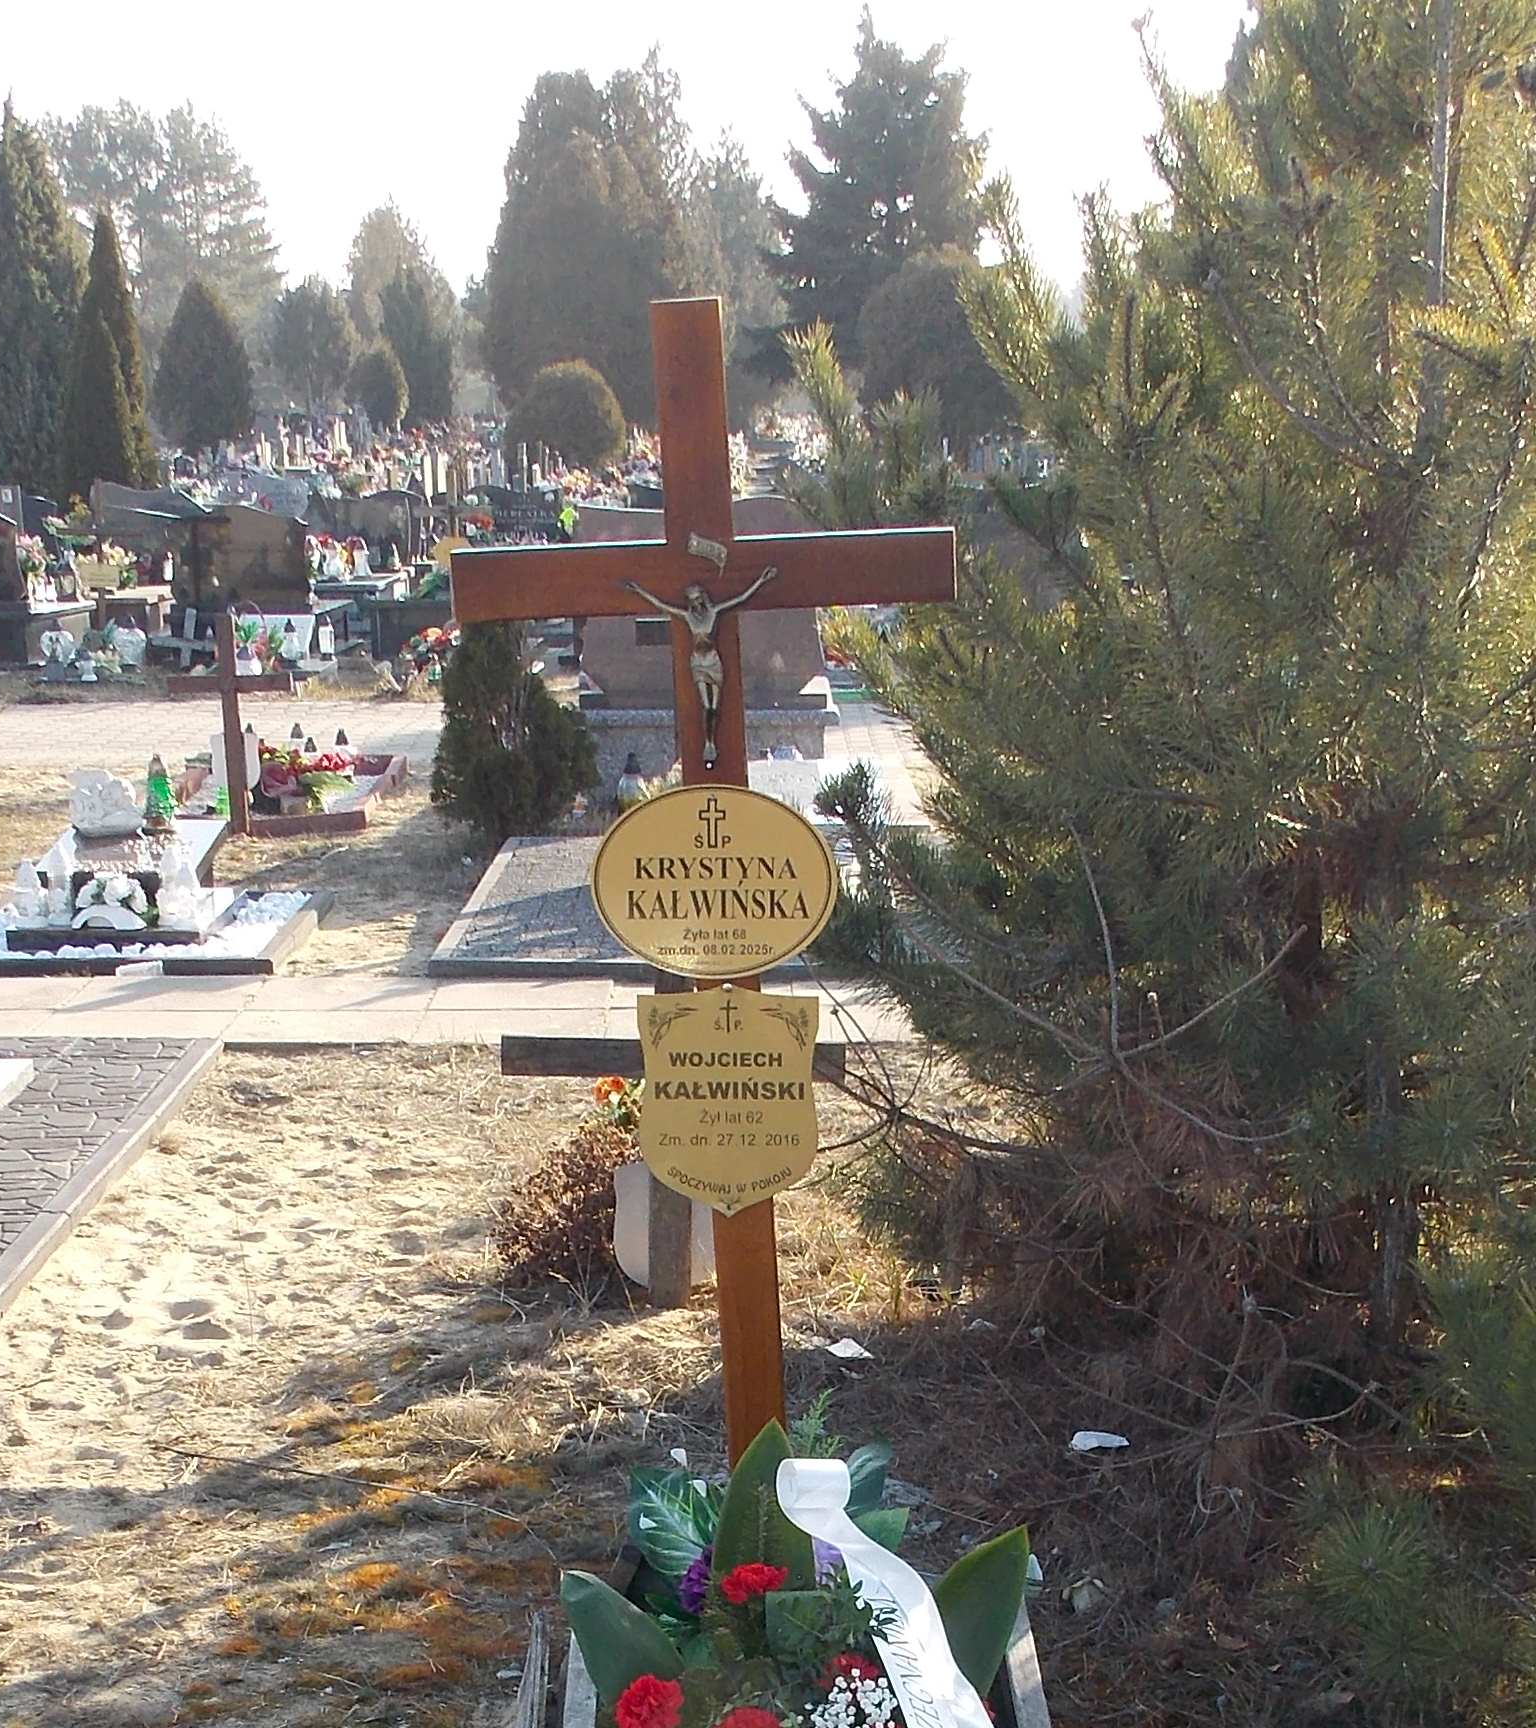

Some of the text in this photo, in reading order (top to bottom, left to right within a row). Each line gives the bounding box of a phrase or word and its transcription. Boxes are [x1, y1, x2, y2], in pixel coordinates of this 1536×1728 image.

[694, 833, 731, 849] Ś P
[633, 857, 797, 880] KRYSTYNA
[627, 879, 810, 920] KAŁWIŃSKA
[683, 927, 747, 943] Żyła lat 68
[669, 1052, 783, 1068] WOJCIECH
[654, 1077, 805, 1100] KAŁWIŃSKI
[699, 1108, 764, 1126] Żył lat 62
[667, 1166, 732, 1195] SPOCZYWAJ
[751, 1167, 792, 1192] POKOJU
